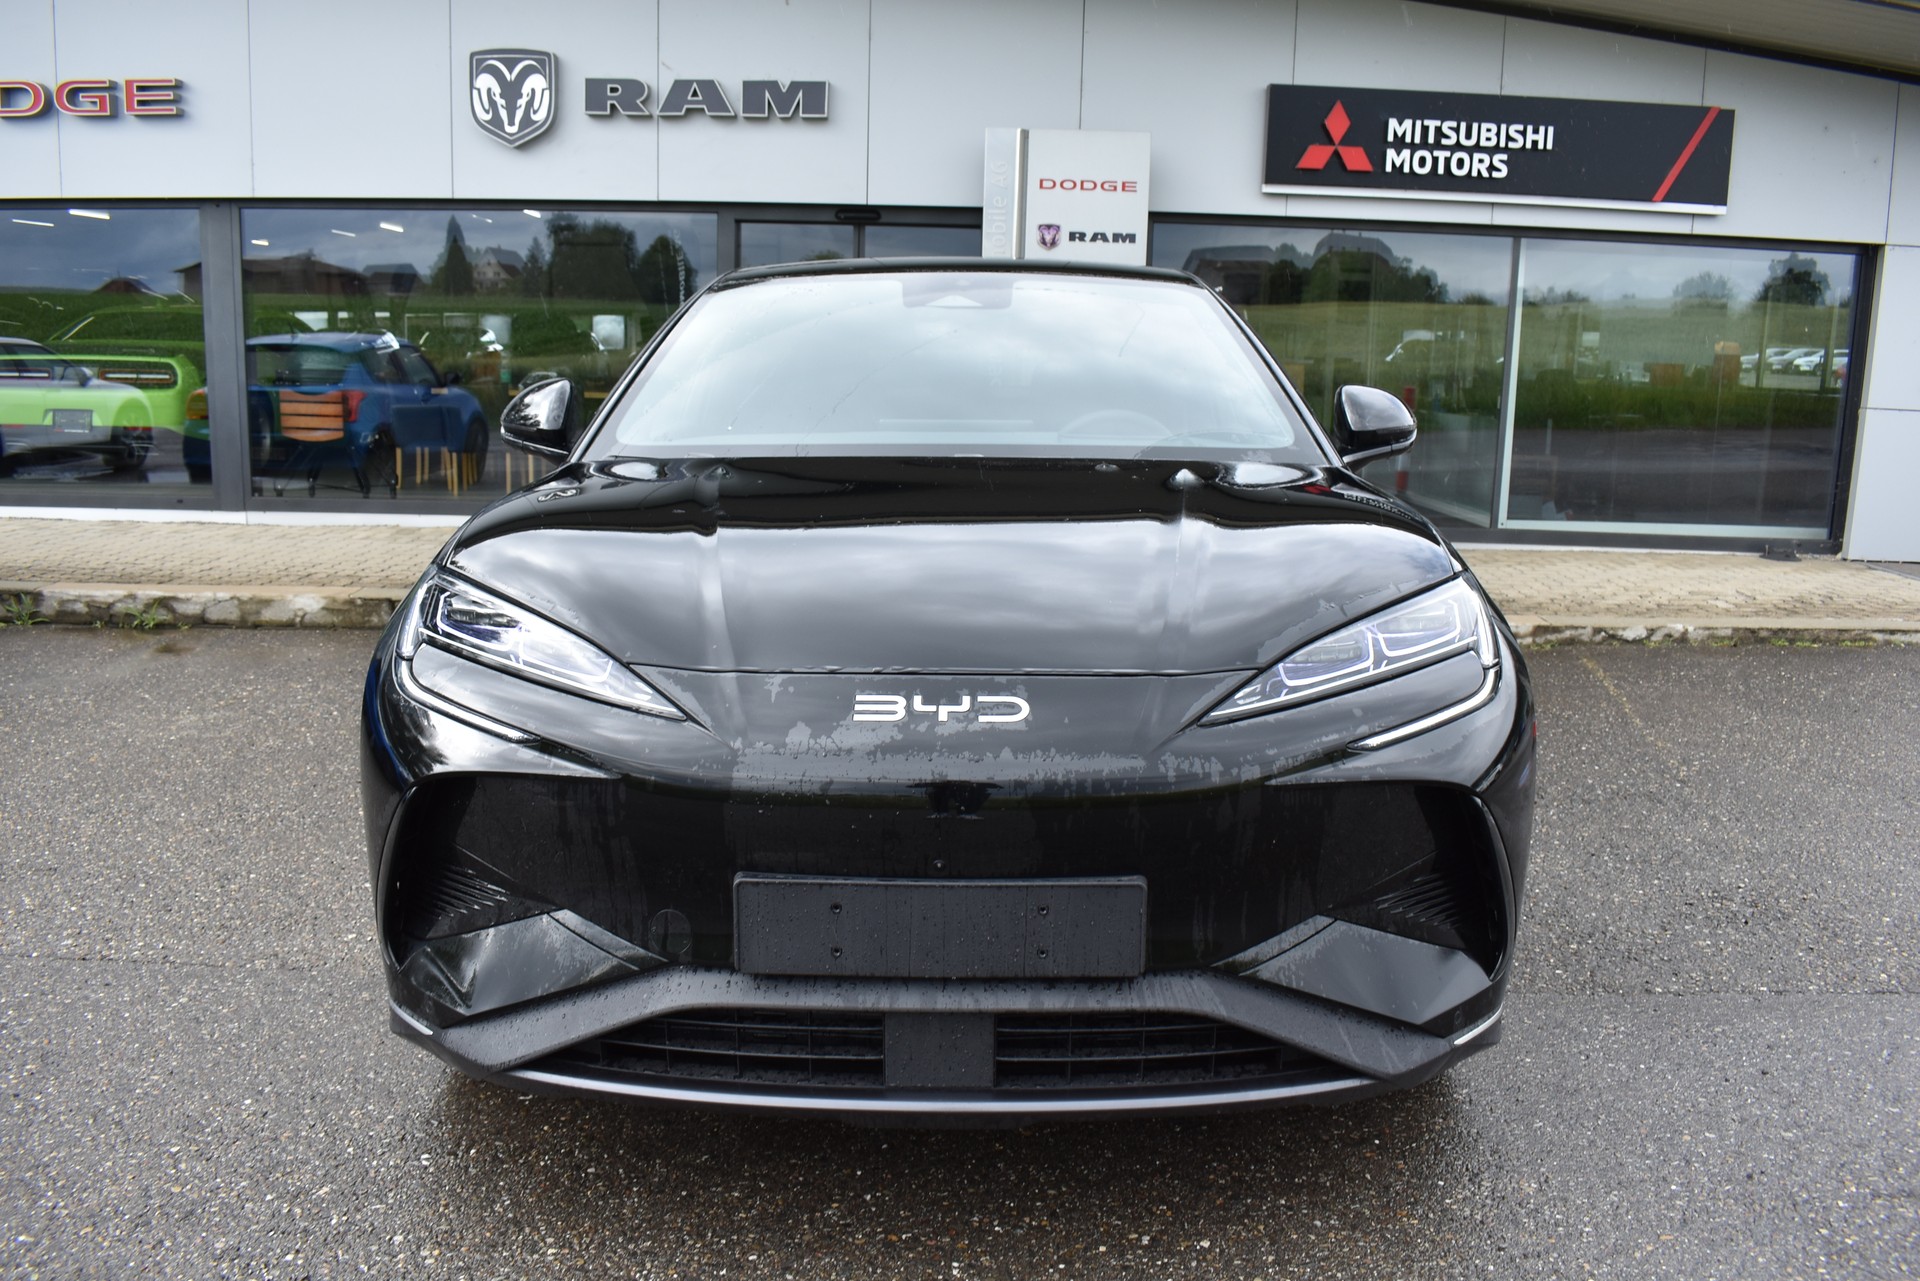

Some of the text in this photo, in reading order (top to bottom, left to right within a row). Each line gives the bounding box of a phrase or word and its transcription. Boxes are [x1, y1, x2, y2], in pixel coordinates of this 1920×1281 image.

[585, 77, 830, 118] RAM
[1386, 117, 1555, 150] MITSUBISHI
[1384, 147, 1509, 179] MOTORS
[1038, 178, 1138, 193] DODGE
[1068, 230, 1137, 244] RAM
[852, 694, 1031, 723] BYD
